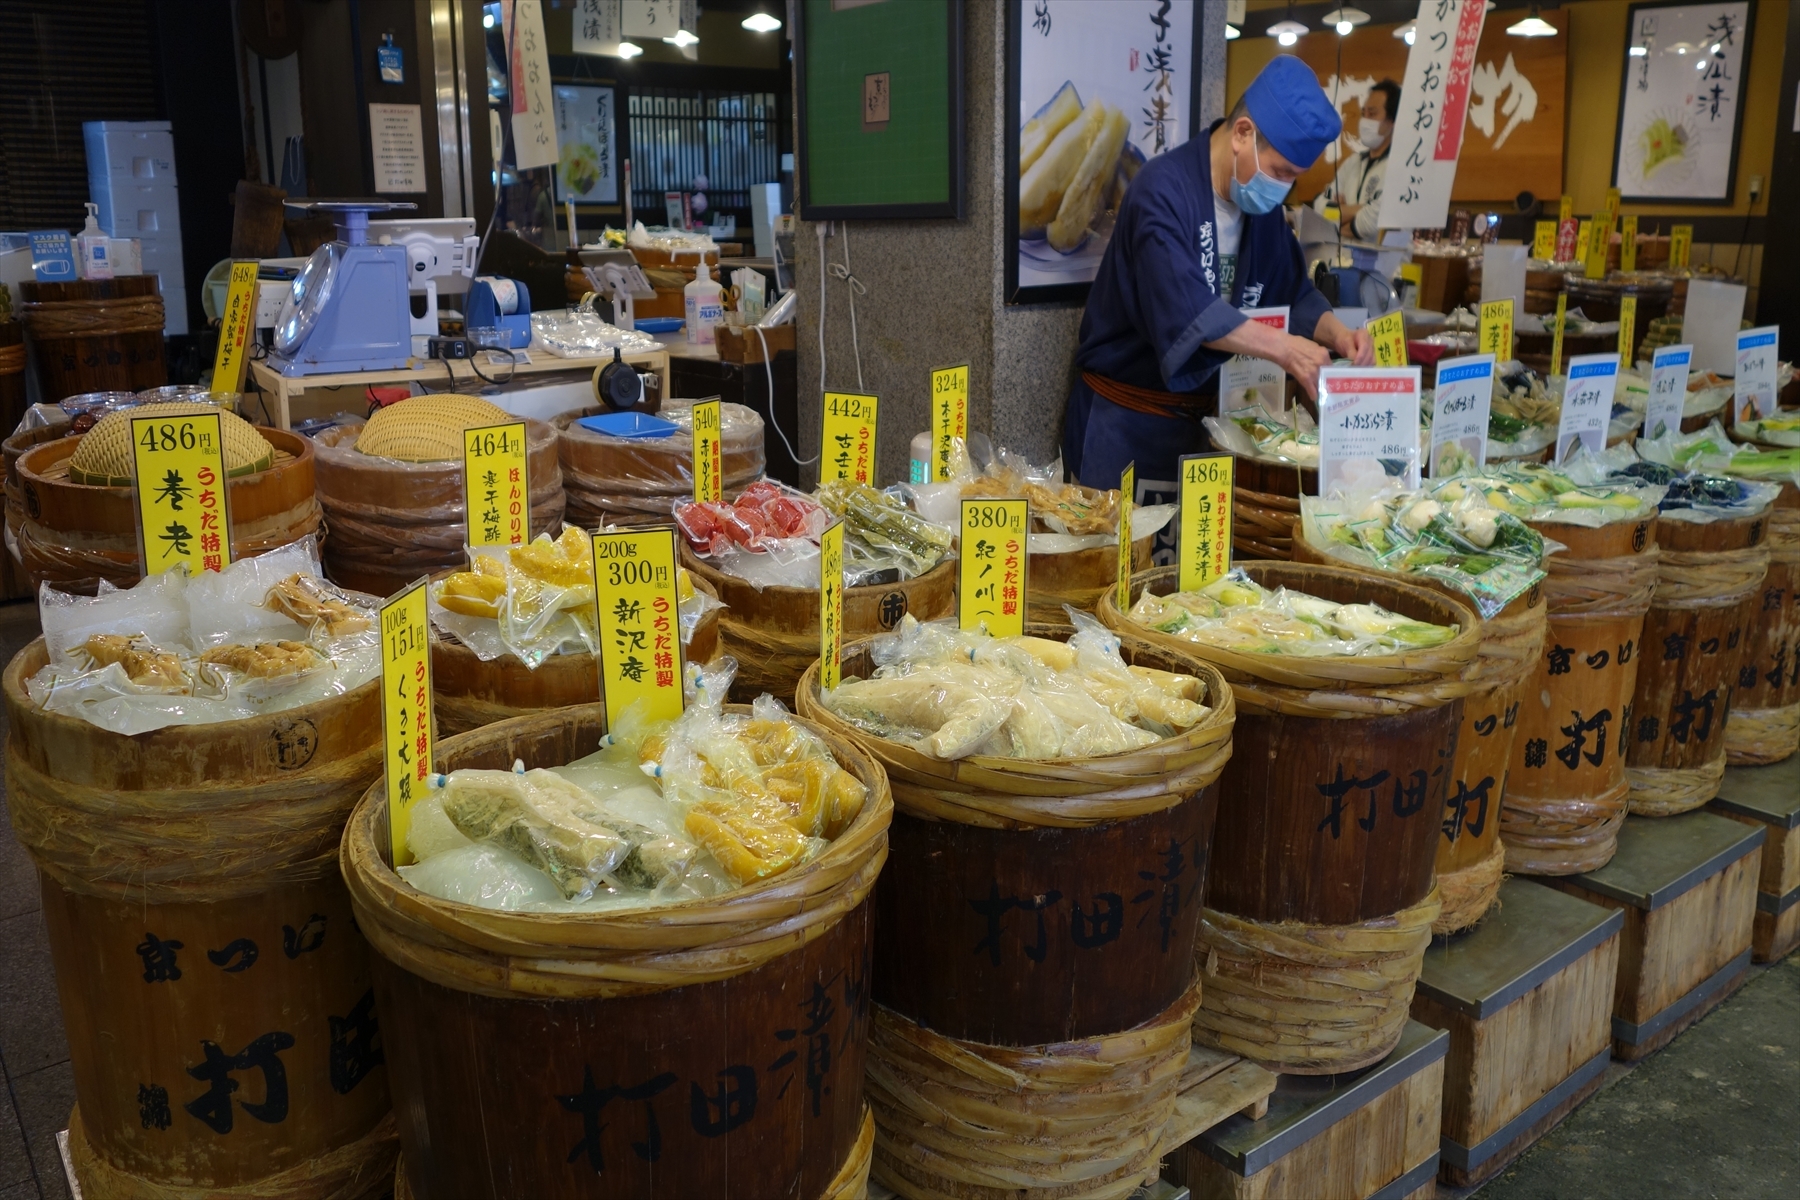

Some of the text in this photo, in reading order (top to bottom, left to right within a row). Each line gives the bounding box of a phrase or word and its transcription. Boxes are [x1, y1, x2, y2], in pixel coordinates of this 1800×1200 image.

[1399, 0, 1456, 204] かつおおんぶ
[936, 372, 965, 394] 324円
[827, 397, 872, 420] 442円
[956, 398, 965, 440] うちだ
[1339, 408, 1398, 432] 小かぶら漬
[140, 423, 211, 453] 486円
[469, 430, 520, 458] 464円
[1380, 444, 1407, 456] 486円
[1185, 461, 1228, 484] 486円
[197, 466, 222, 574] うちだ特製
[967, 506, 1020, 528] 380円
[598, 540, 638, 559] 200g
[1194, 494, 1213, 583] 白菜浅漬
[608, 559, 668, 586] 300円
[1002, 539, 1020, 616] うちだ特製
[384, 606, 408, 635] 100g
[390, 623, 425, 663] 151円
[612, 597, 651, 683] 新沢庵
[652, 596, 674, 688] うちだ特製
[1547, 638, 1641, 676] 京つけ
[397, 673, 413, 808] くき大根
[414, 660, 429, 783] うちだ特製
[136, 912, 362, 984] 京つけ
